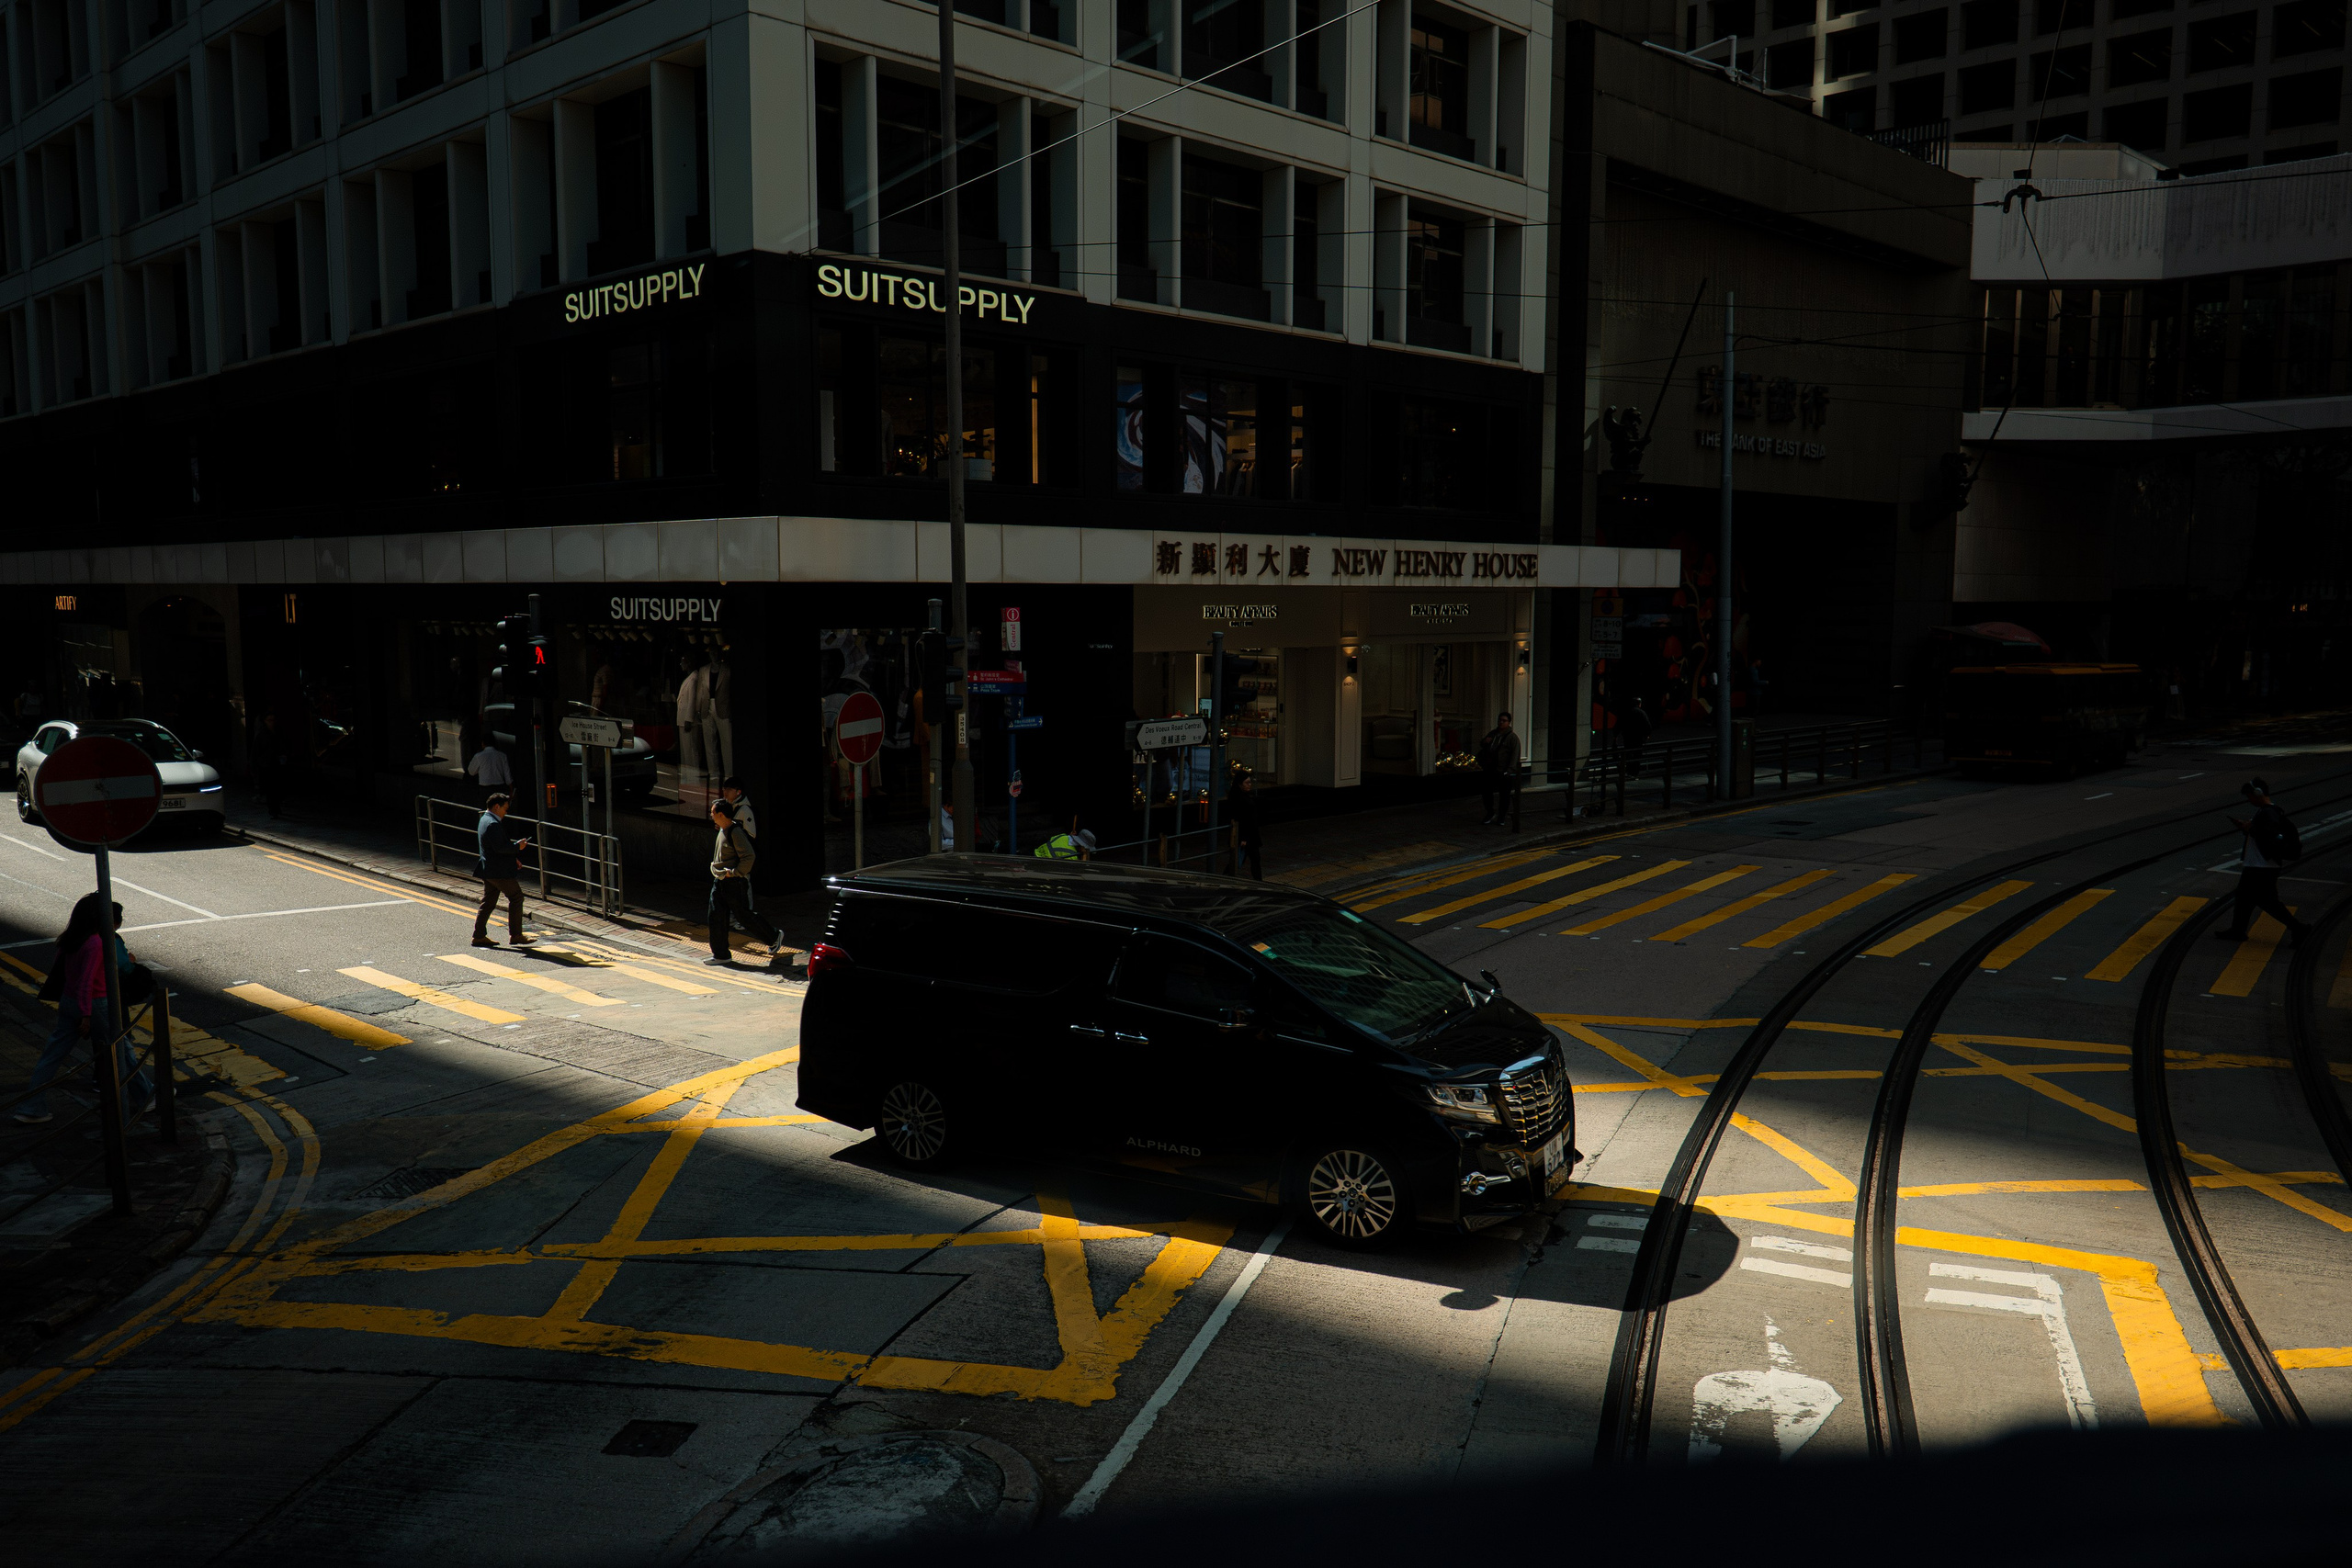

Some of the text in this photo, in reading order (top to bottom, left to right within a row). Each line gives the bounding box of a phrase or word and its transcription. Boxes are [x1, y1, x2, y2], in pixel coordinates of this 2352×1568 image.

[565, 264, 706, 323] SUITSUPPLY
[817, 265, 1036, 324] SUITSUPPLY
[1698, 431, 1723, 448] THE
[1757, 436, 1773, 453] OF
[1774, 438, 1802, 457] EAST
[1803, 443, 1826, 459] ASIA
[1156, 540, 1311, 577] 新顯利大廈
[1331, 548, 1539, 579] NEW HENRY HOUSE
[55, 595, 77, 611] ARTIFY
[610, 596, 722, 622] SUITSUPPLY
[1203, 604, 1279, 618] BEAUTY AFFAIRS
[579, 721, 593, 729] House
[593, 722, 607, 731] Street
[1184, 722, 1202, 730] Central
[163, 799, 182, 807] 9681
[1126, 1136, 1202, 1157] ALPHARD
